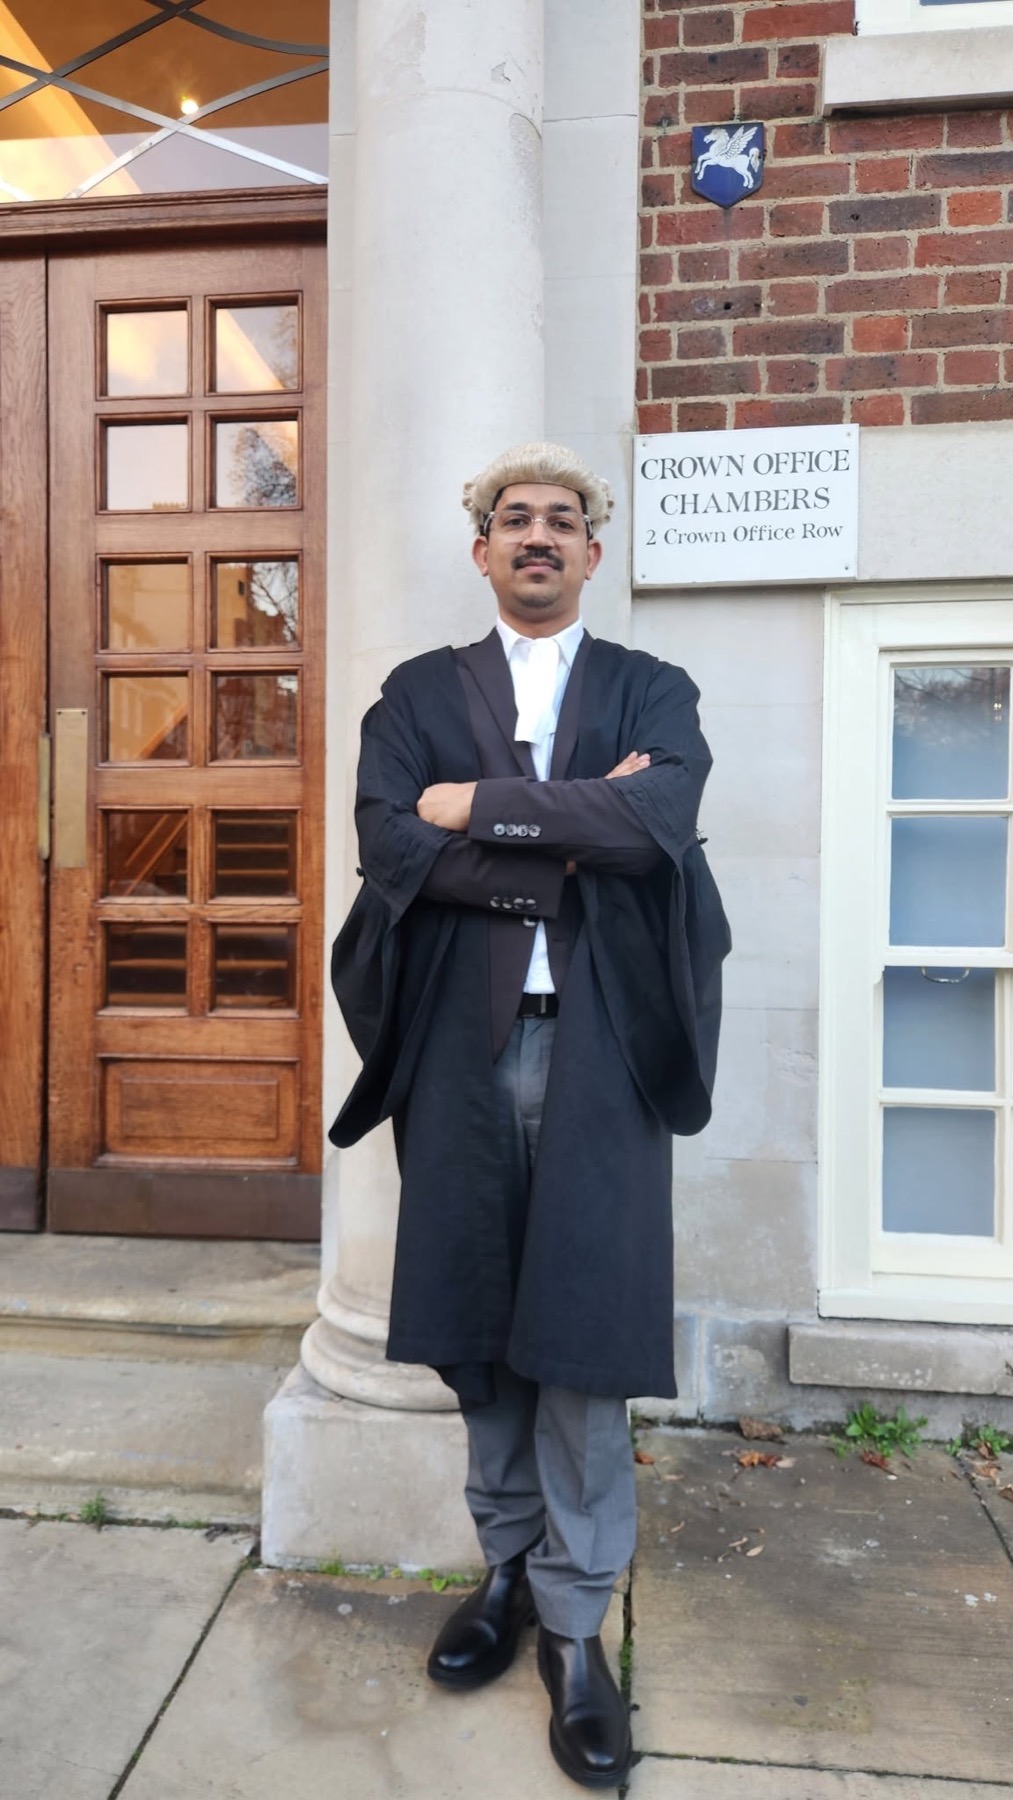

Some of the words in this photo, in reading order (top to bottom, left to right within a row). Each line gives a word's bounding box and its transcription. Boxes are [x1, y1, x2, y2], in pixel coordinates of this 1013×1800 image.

[640, 454, 745, 480] CROWN
[753, 449, 850, 475] OFFICE
[660, 487, 830, 515] CHAMBERS
[646, 529, 657, 545] 2
[664, 528, 726, 545] Crown
[733, 525, 795, 542] Office
[802, 523, 843, 539] Row
